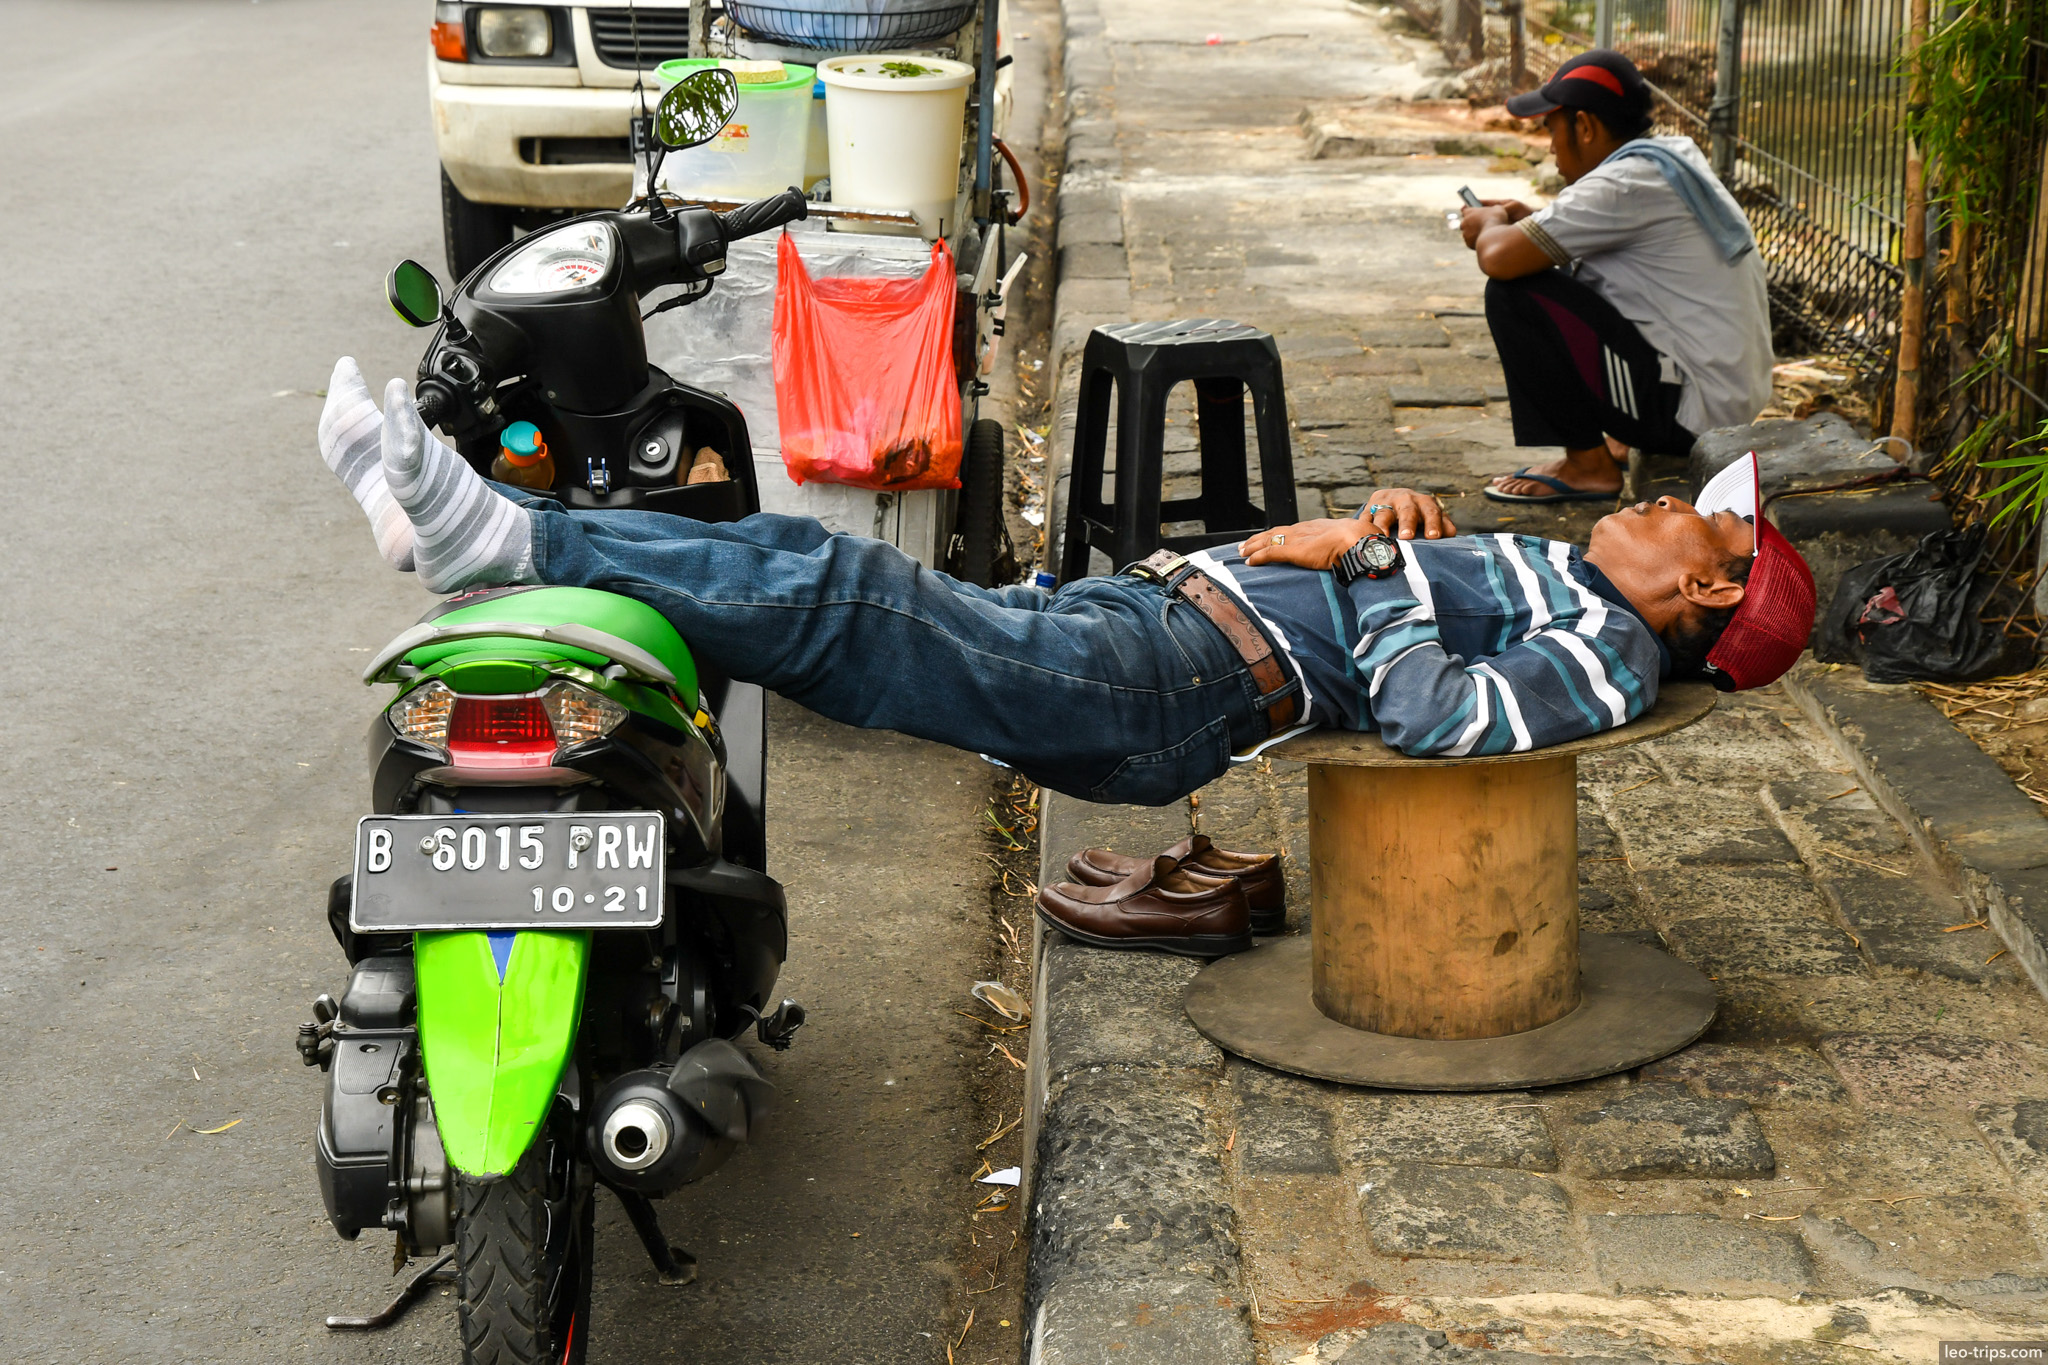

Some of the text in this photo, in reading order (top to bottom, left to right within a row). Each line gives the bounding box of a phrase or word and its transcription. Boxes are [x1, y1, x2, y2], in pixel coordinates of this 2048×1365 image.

[367, 824, 656, 872] B 6015 PRW
